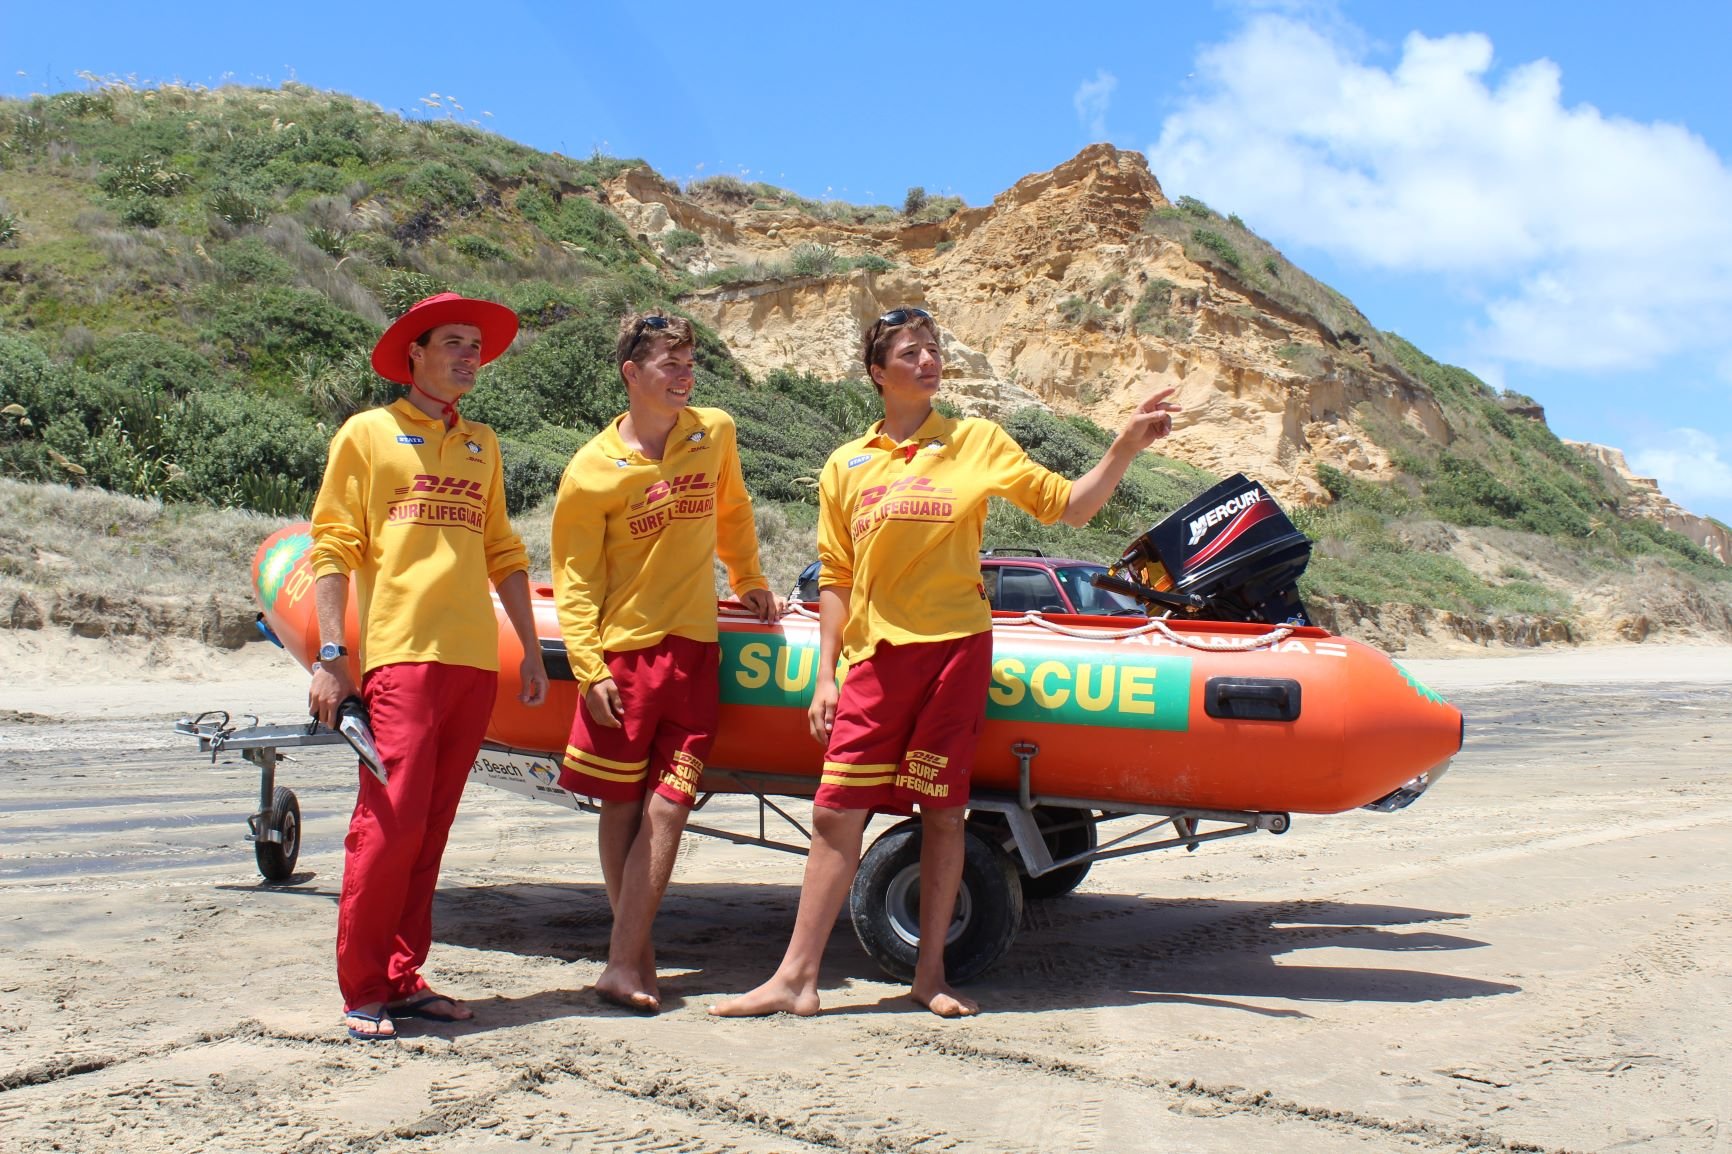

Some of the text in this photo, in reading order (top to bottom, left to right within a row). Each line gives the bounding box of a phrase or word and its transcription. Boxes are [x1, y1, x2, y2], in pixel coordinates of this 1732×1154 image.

[412, 474, 483, 501] DHL
[644, 473, 709, 505] DHL
[861, 476, 936, 508] DHL
[389, 503, 485, 528] SURF LIFEGUAR
[629, 497, 714, 536] SURF LGUARD
[873, 500, 953, 524] LIFEGUARD
[1187, 488, 1261, 545] MERCURY
[285, 561, 314, 608] bp
[989, 659, 1157, 715] SCUE
[482, 758, 523, 777] Beach
[908, 761, 939, 781] SURF
[911, 752, 943, 765] DHL
[658, 769, 697, 798] LIFEGU
[675, 764, 699, 785] SUR
[895, 774, 949, 797] IFEGUARD
